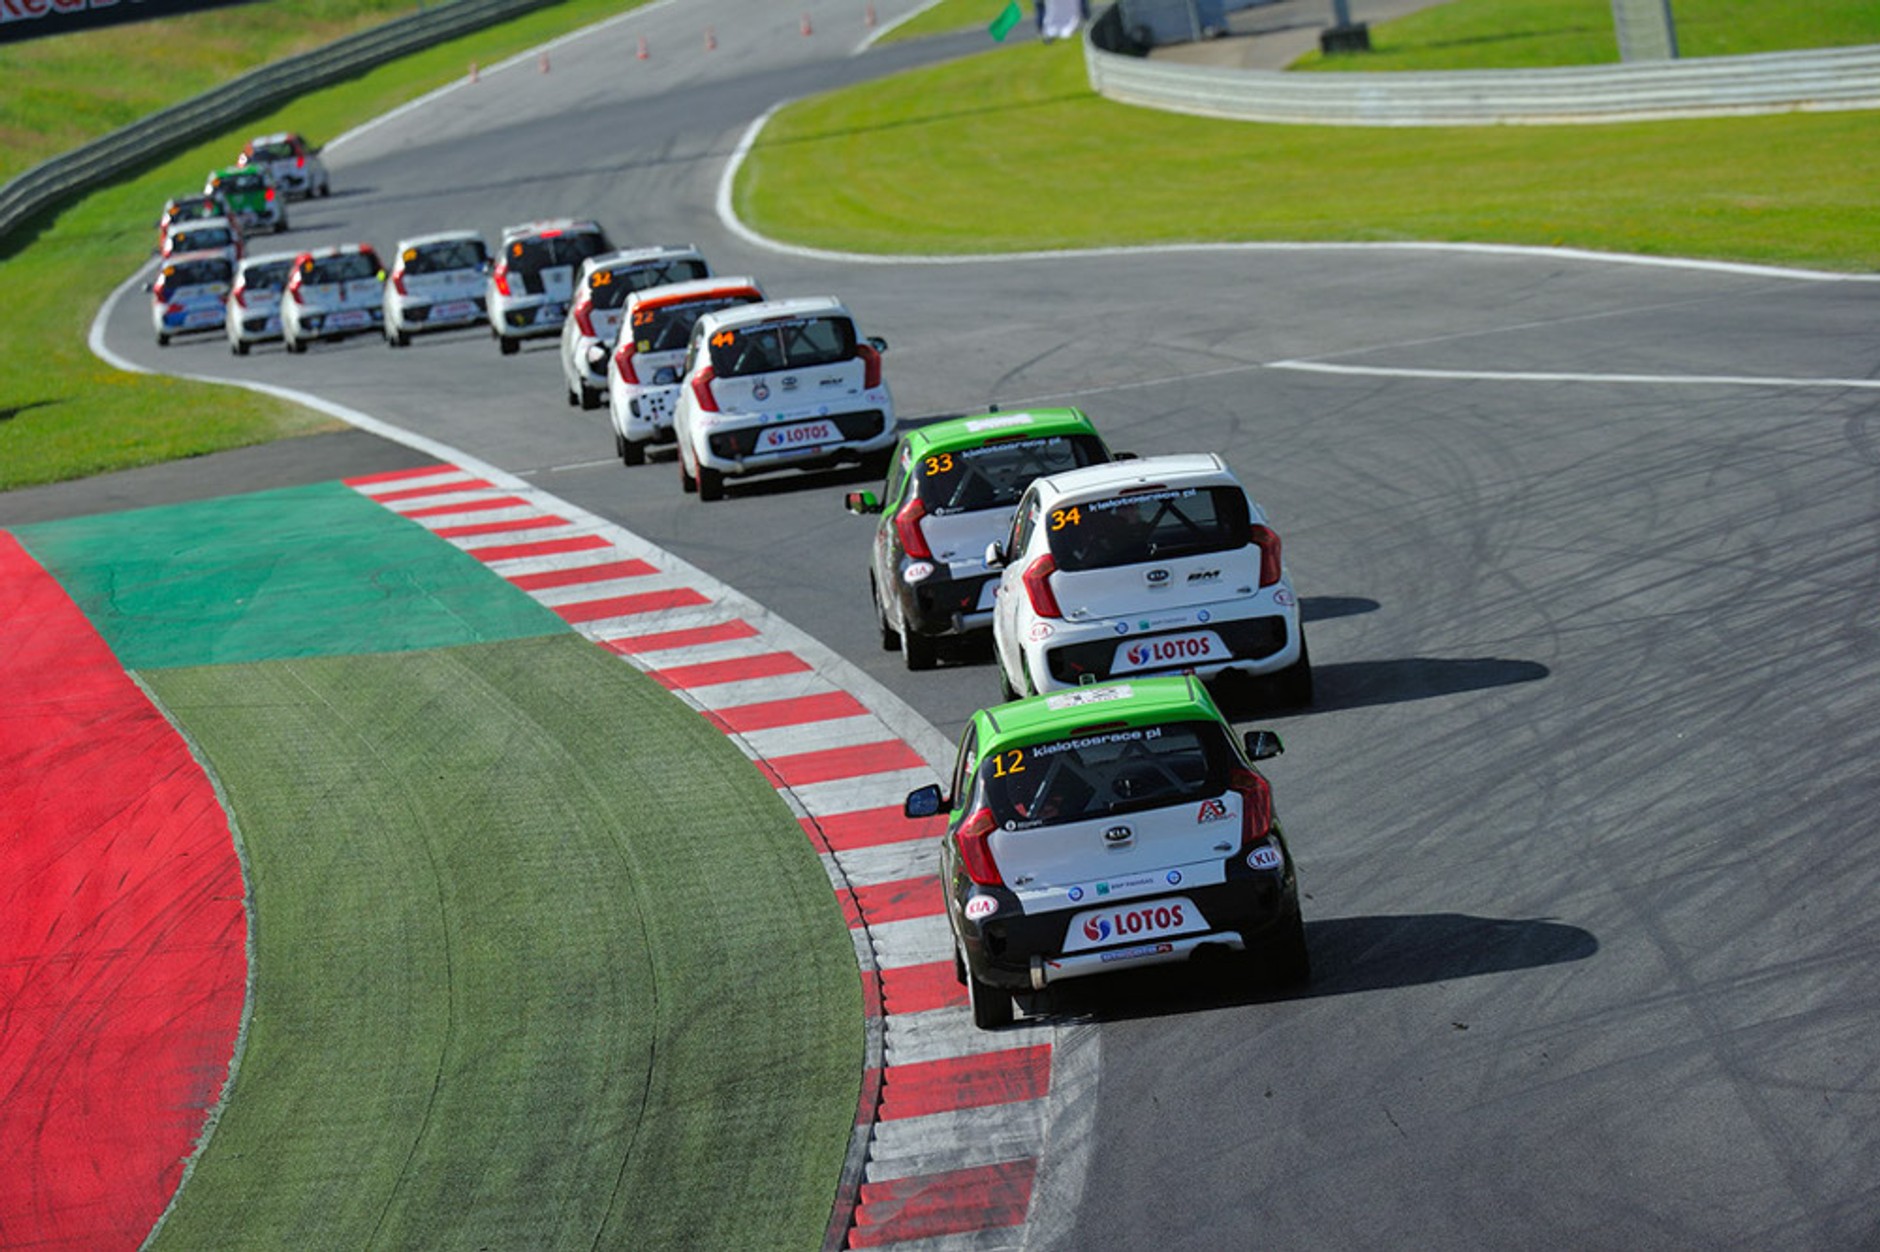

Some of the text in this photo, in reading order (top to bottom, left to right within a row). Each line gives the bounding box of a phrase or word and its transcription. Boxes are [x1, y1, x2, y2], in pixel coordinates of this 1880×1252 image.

[633, 311, 654, 327] 22
[711, 331, 735, 348] 44
[786, 424, 830, 443] LOTOS
[924, 453, 953, 476] 33
[1051, 506, 1082, 531] 34
[909, 565, 929, 577] KIA
[1153, 636, 1210, 661] LOTOS
[992, 749, 1026, 778] 12
[1108, 827, 1129, 840] KIA
[969, 900, 991, 914] KIA
[1115, 904, 1184, 935] LOTOS
